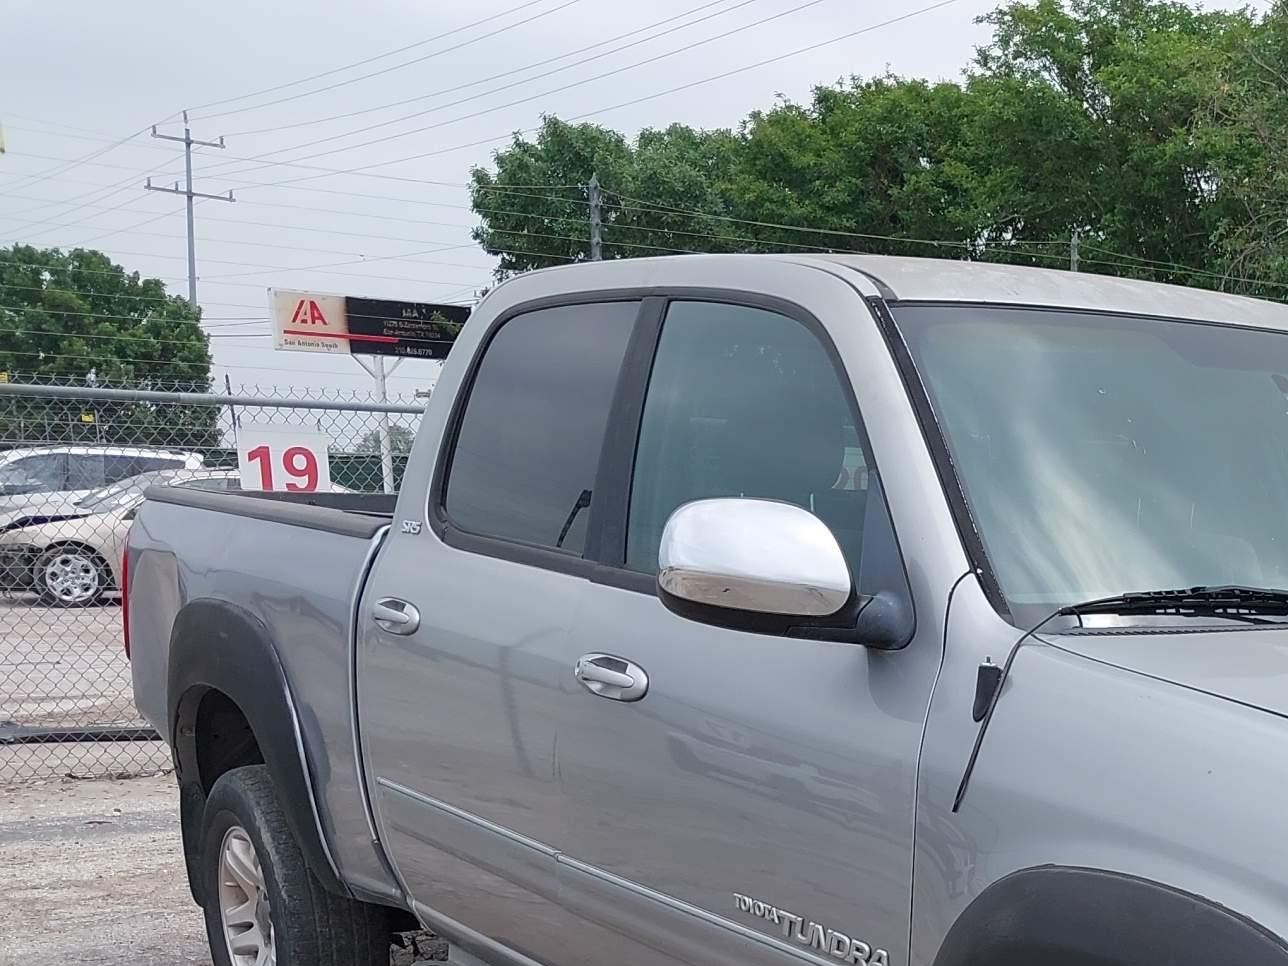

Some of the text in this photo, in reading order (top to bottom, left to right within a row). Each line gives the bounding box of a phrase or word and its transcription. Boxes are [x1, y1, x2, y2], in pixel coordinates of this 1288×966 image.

[284, 338, 296, 346] San
[297, 339, 320, 348] Antonio
[247, 446, 319, 492] 19
[733, 892, 780, 925] TOYOTA
